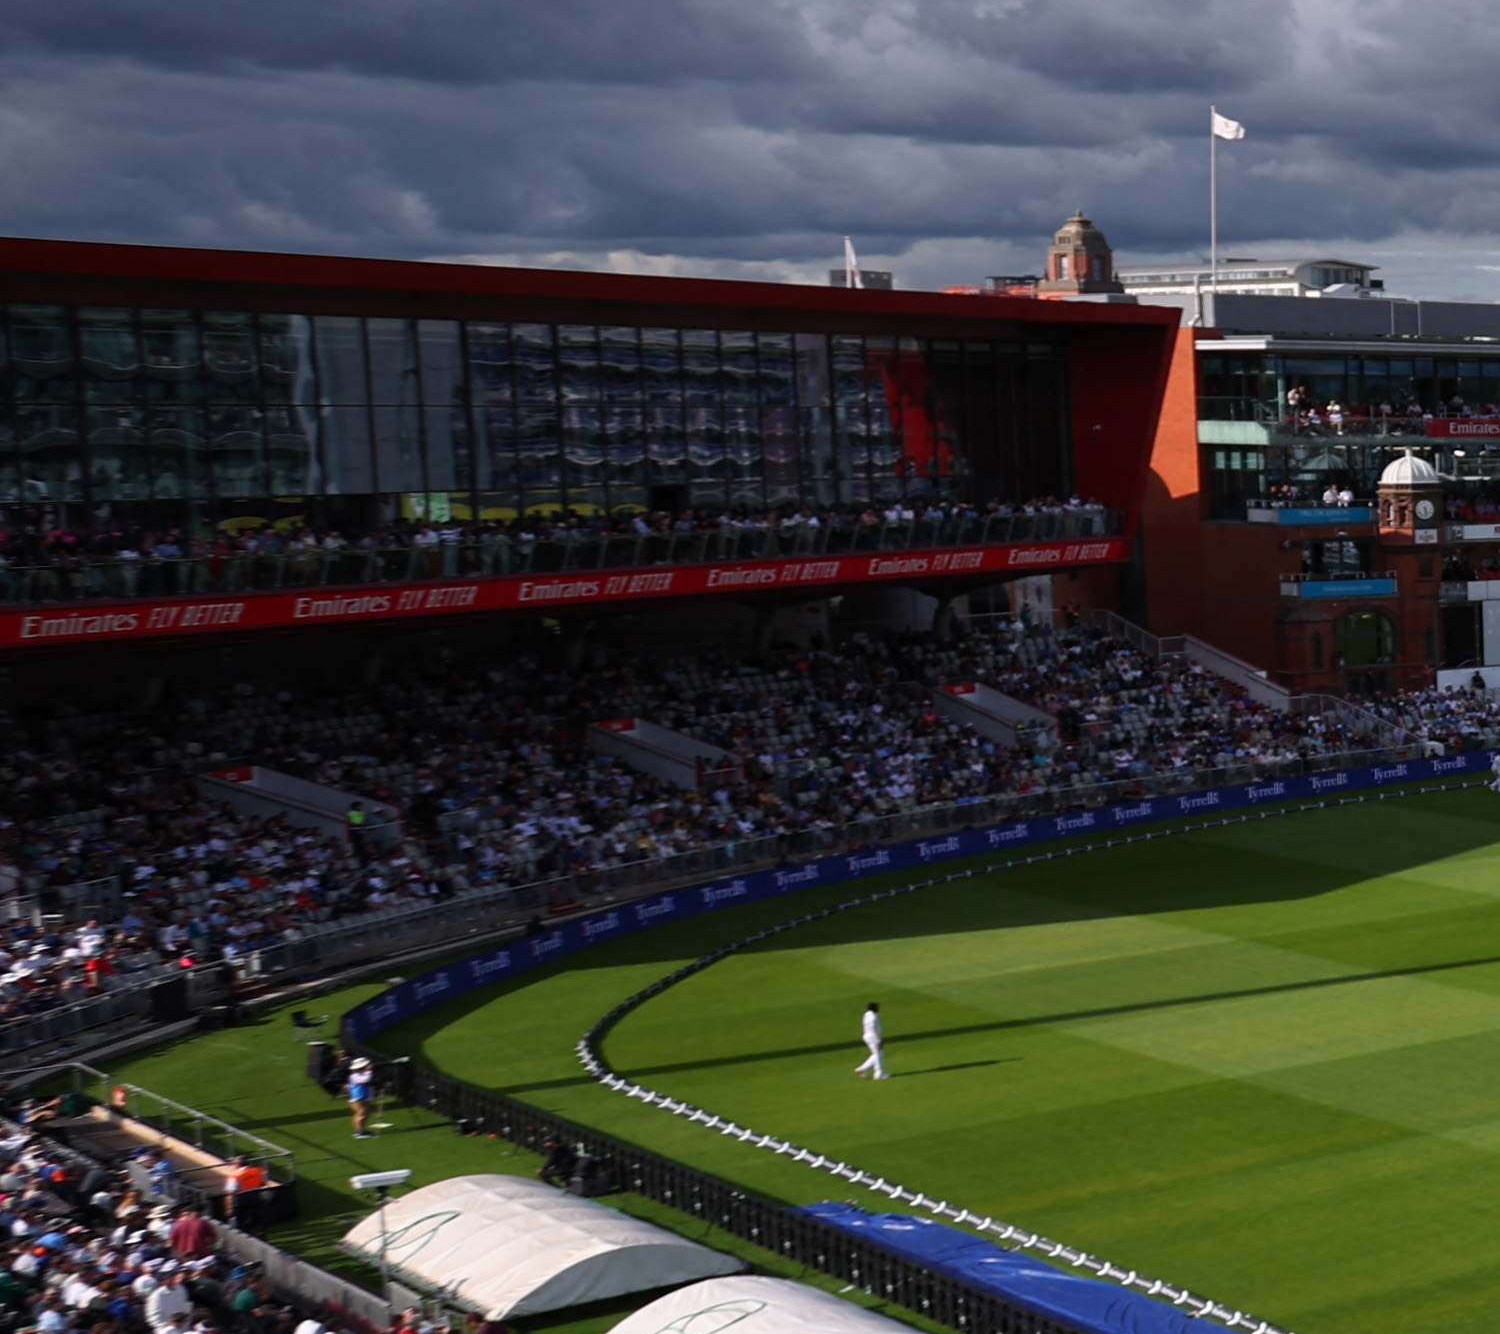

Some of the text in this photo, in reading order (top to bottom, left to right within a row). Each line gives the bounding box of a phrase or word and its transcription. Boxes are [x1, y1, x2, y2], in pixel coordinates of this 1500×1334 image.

[1450, 421, 1500, 434] Emirates
[294, 594, 391, 619] Emirates
[425, 585, 478, 608] BETTER
[518, 579, 600, 601] Emirates
[627, 571, 674, 593] BETTER
[19, 613, 139, 639] Emirates
[180, 601, 245, 627] BETTER
